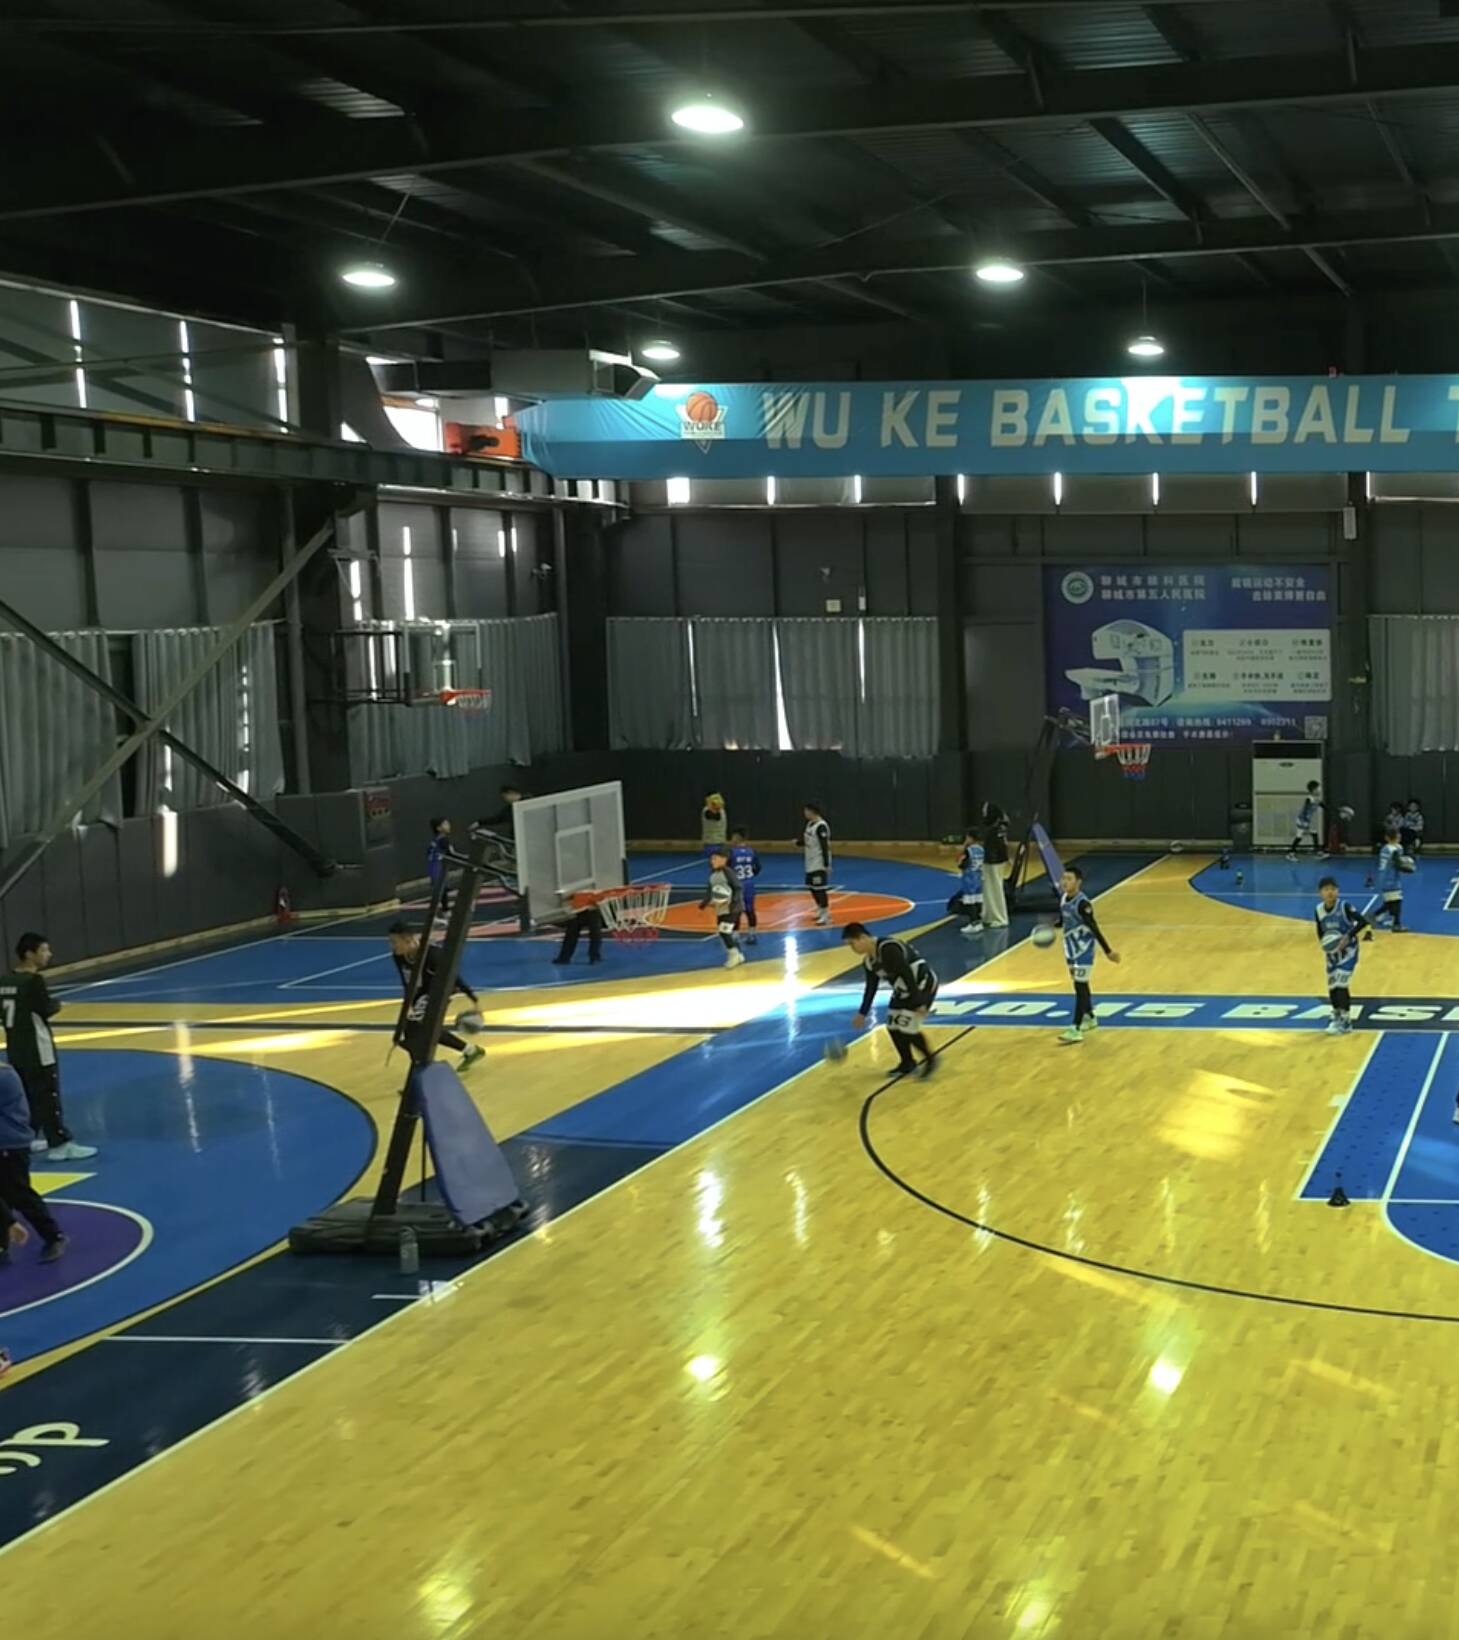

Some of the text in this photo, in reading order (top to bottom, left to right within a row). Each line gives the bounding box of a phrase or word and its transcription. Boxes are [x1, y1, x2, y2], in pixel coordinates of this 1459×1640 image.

[762, 389, 848, 450] WU
[880, 388, 961, 449] KE
[990, 383, 1411, 448] BASKETBALL
